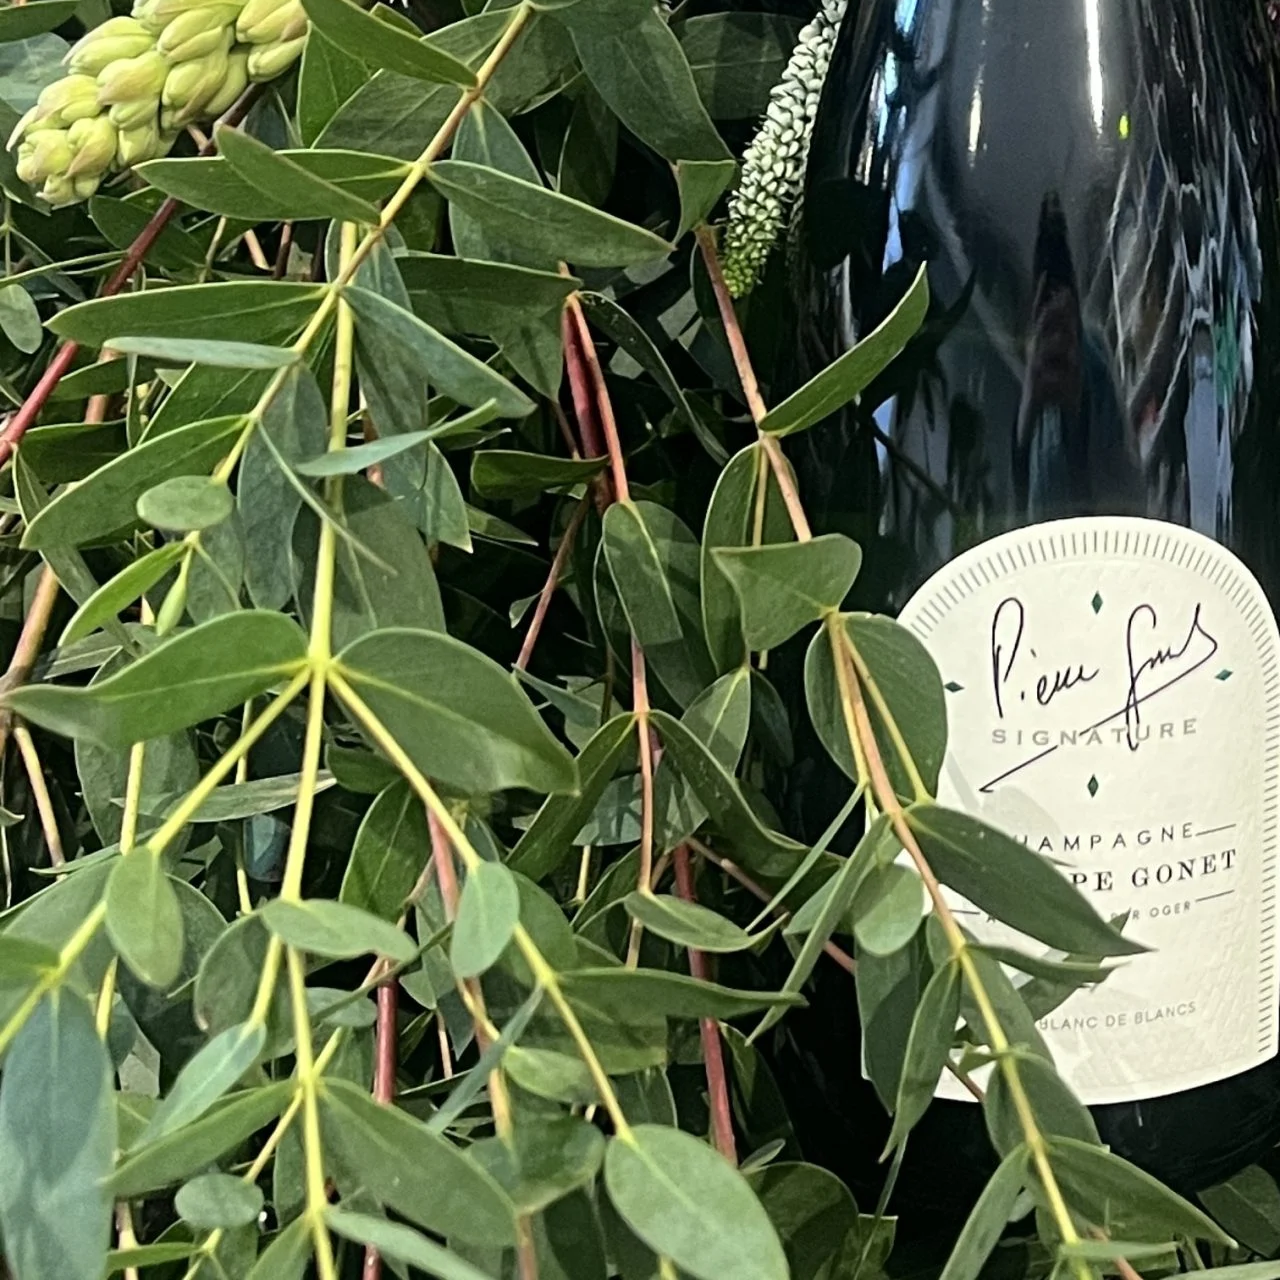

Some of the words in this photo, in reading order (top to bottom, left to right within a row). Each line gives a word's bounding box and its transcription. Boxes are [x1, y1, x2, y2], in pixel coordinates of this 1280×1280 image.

[991, 718, 1197, 746] SIGNATURE
[1131, 849, 1237, 888] GONET
[1149, 901, 1192, 918] OGER
[1038, 1015, 1099, 1031] BLANC
[1105, 1013, 1128, 1028] DE
[1134, 1001, 1197, 1025] BLANCS
